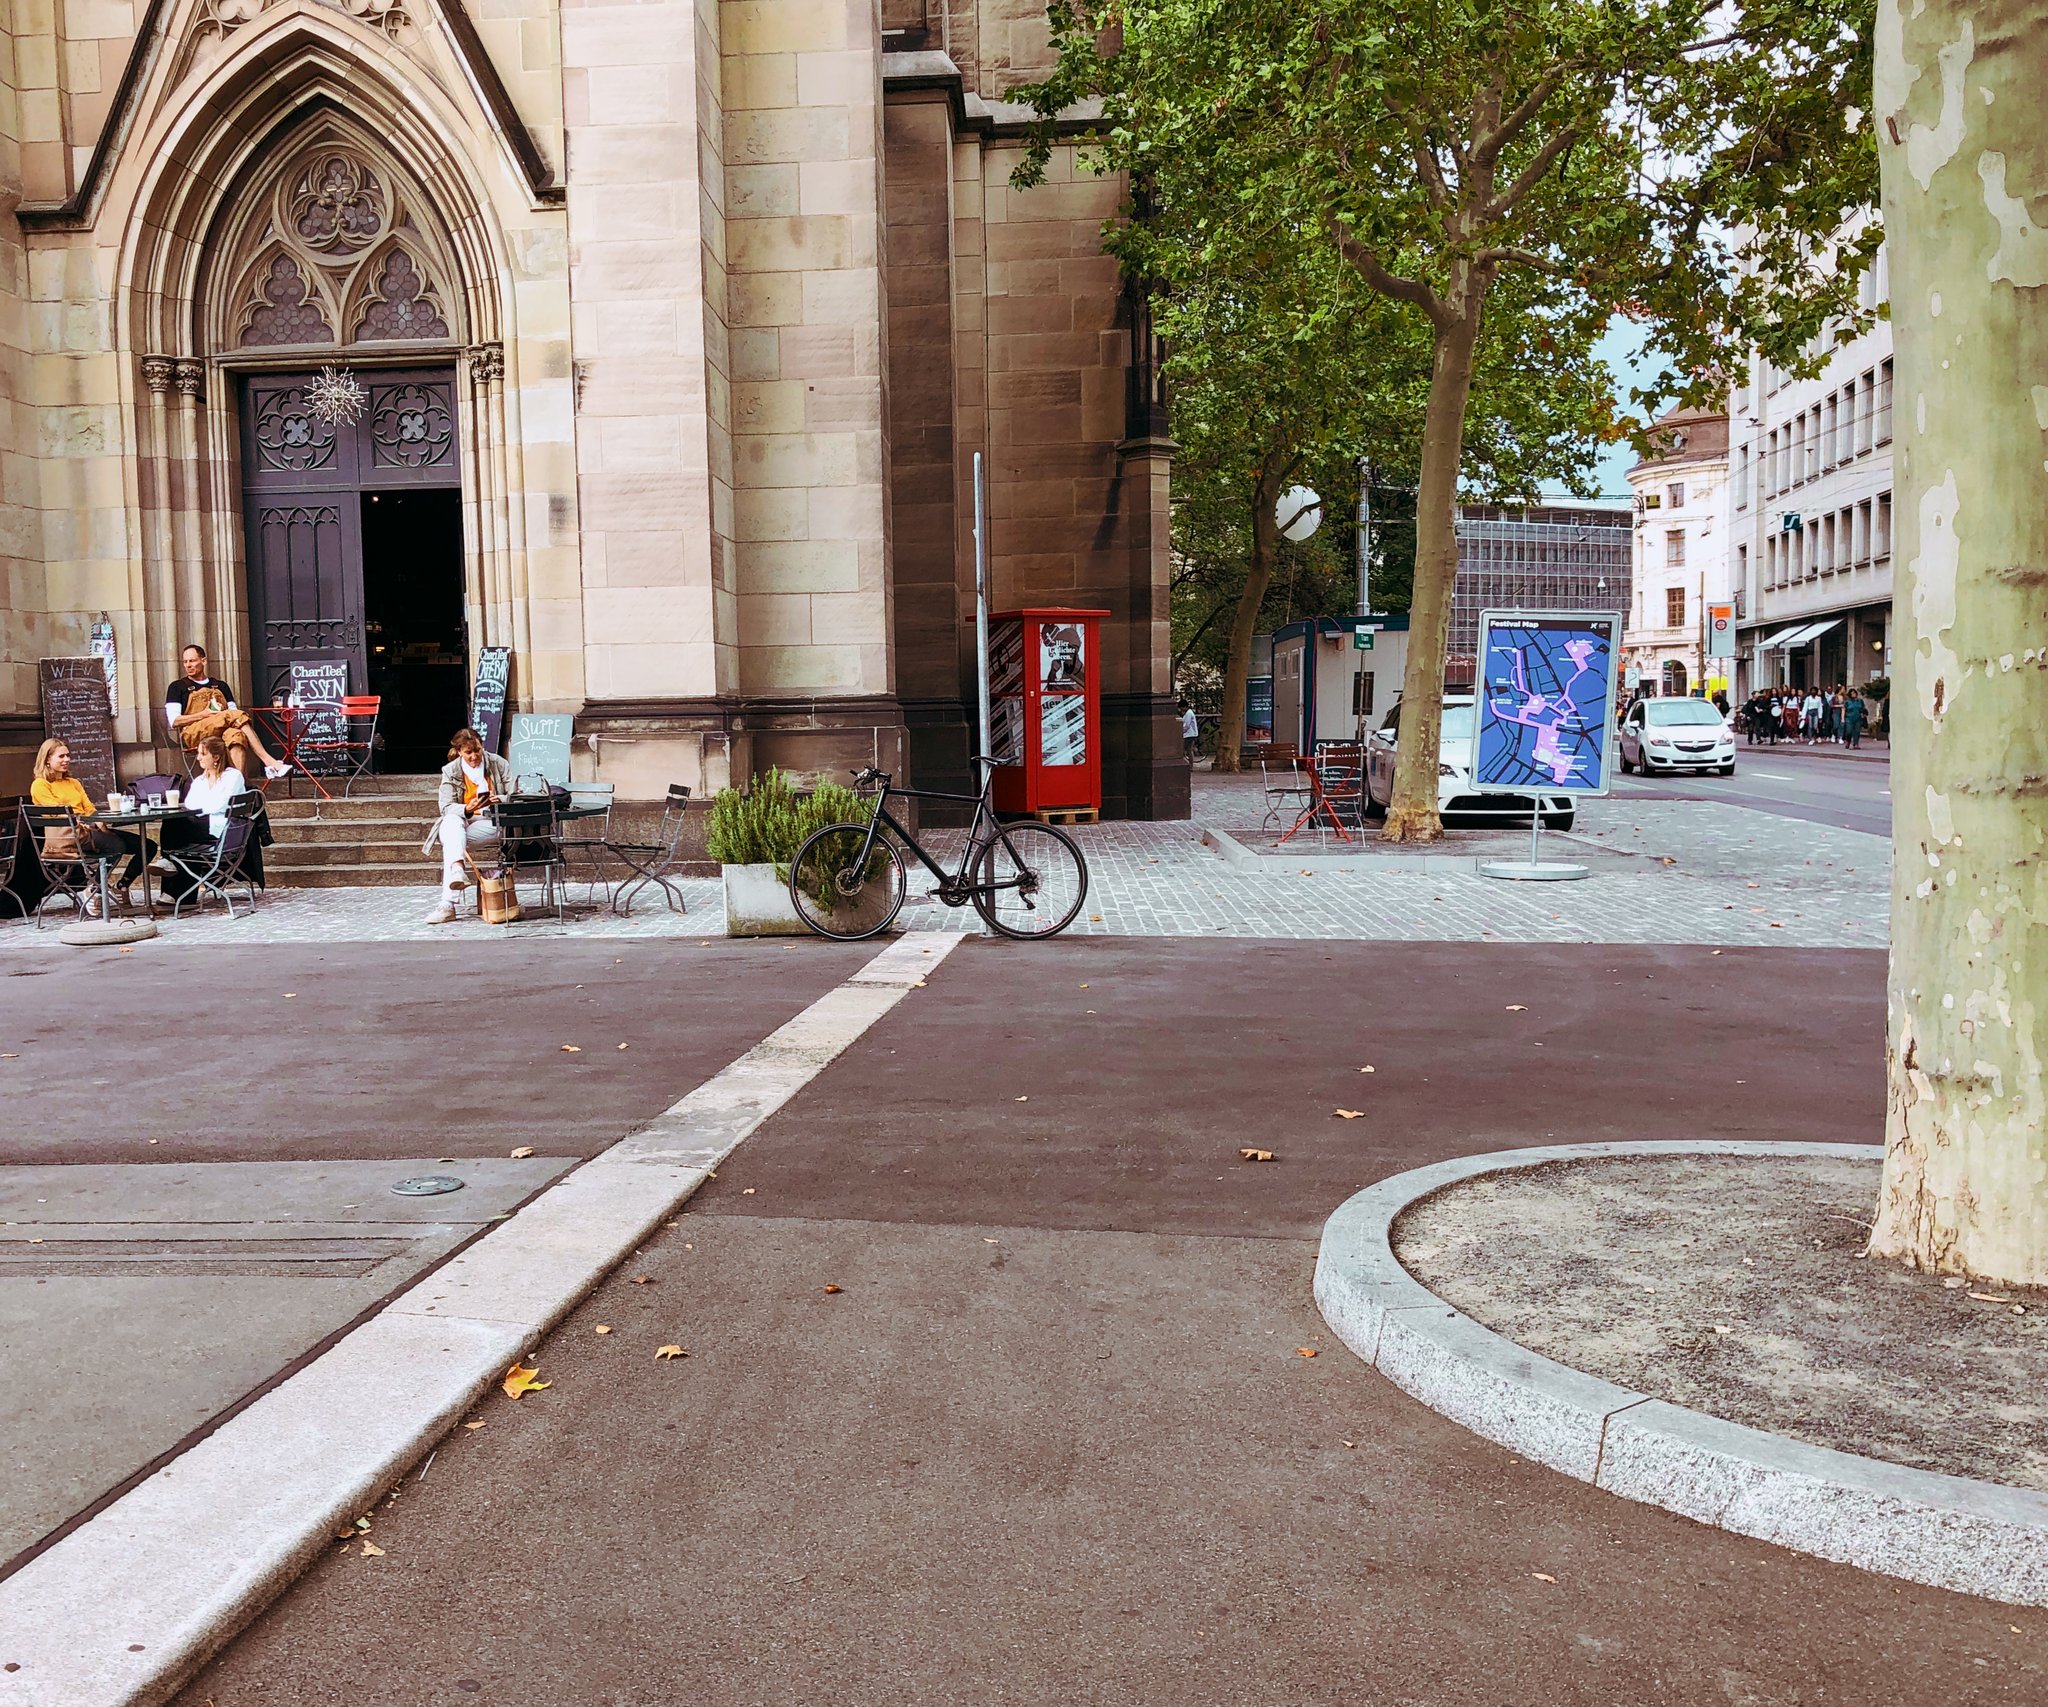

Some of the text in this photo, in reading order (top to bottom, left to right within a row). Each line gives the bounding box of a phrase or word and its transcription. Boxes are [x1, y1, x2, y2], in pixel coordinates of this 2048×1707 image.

[1490, 620, 1539, 629] Festival Map
[292, 664, 346, 678] ChariTea
[297, 677, 346, 700] ESSEN
[519, 717, 561, 740] SUPPE
